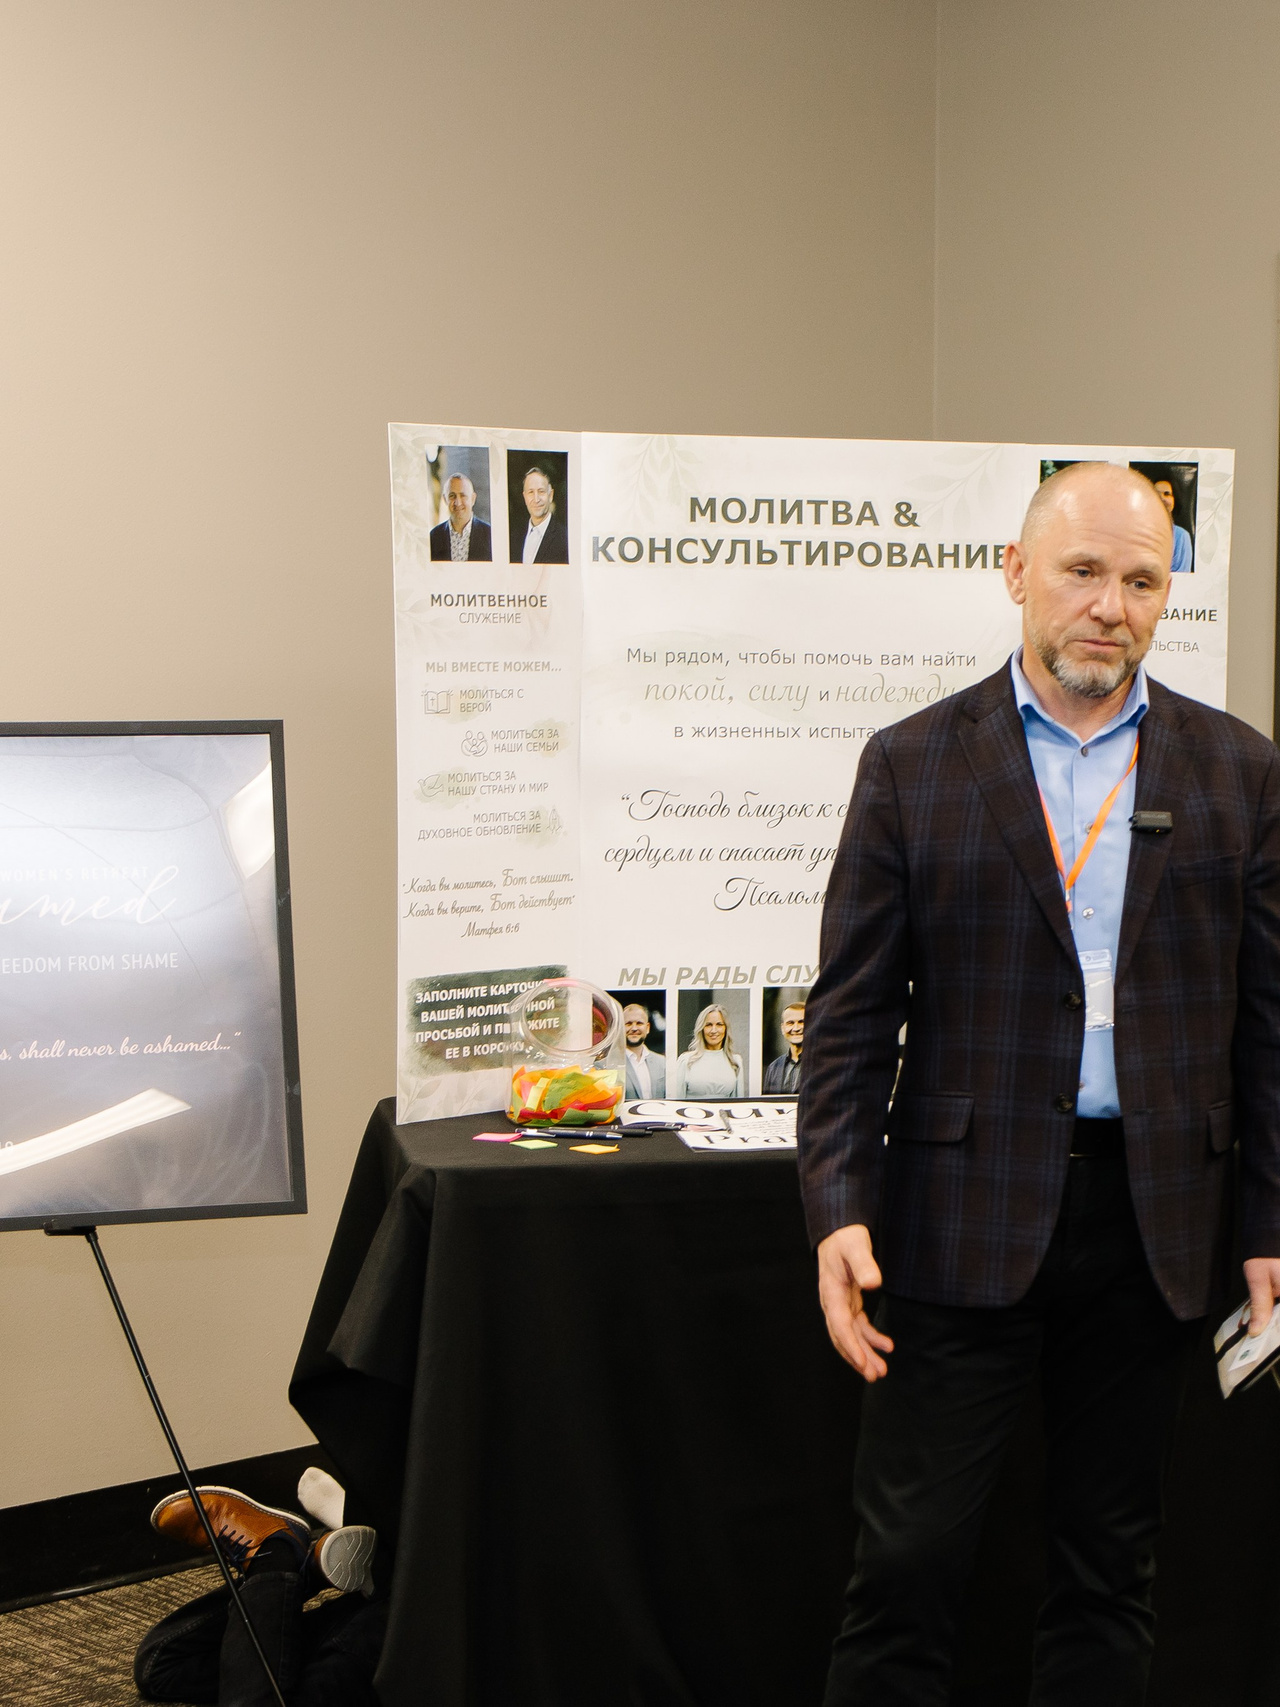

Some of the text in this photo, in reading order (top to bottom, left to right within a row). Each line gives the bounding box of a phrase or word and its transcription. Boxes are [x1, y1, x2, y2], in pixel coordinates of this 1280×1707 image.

[690, 497, 921, 527] МОЛИТВА &
[430, 593, 548, 608] МОЛИТВЕННОЕ
[459, 612, 522, 624] СЛУЖЕНИЕ
[626, 647, 977, 668] Мы рядом, чтобы помочь вам найти
[426, 661, 562, 673] МЫ ВМЕСТЕ МОЖЕМ...
[459, 688, 524, 699] МОЛИТЬСЯ С
[644, 678, 734, 705] покой,
[748, 684, 812, 712] силу
[819, 688, 830, 701] и
[460, 701, 492, 713] ВЕРОЙ
[491, 728, 560, 740] МОЛИТЬСЯ ЗА
[673, 725, 882, 741] в жизненных испыта
[494, 741, 559, 753] НАШИ СЕМЬИ
[447, 770, 517, 783] МОЛИТЬСЯ ЗА
[447, 782, 549, 797] НАШУ СТРАНУ И МИР
[473, 810, 541, 824] МОЛИТЬСЯ ЗА
[737, 790, 815, 829] близок
[417, 823, 541, 842] ДУХОВНОЕ ОБНОВЛЕНИЕ
[604, 834, 694, 873] сердцем
[698, 848, 714, 862] и
[718, 842, 806, 863] спасает
[81, 866, 150, 880] RETREAT
[438, 876, 450, 891] вы
[452, 879, 497, 891] молитесь,
[403, 902, 435, 919] Когда
[437, 901, 449, 916] вы
[450, 900, 484, 918] верите,
[460, 920, 503, 939] Матфея
[2, 952, 179, 975] EEDOM FROM SHAME
[617, 964, 821, 988] МЫ РАДЫ СЛУ
[415, 985, 488, 1004] ЗАПОЛНИТЕ
[421, 1004, 464, 1024] ВАШЕЙ
[415, 1022, 481, 1043] ПРОСЬБОЙ
[482, 1023, 492, 1037] И
[19, 1039, 66, 1060] shall
[68, 1043, 117, 1058] never
[119, 1036, 140, 1055] be
[445, 1047, 460, 1060] ЕЕ
[462, 1046, 471, 1058] В
